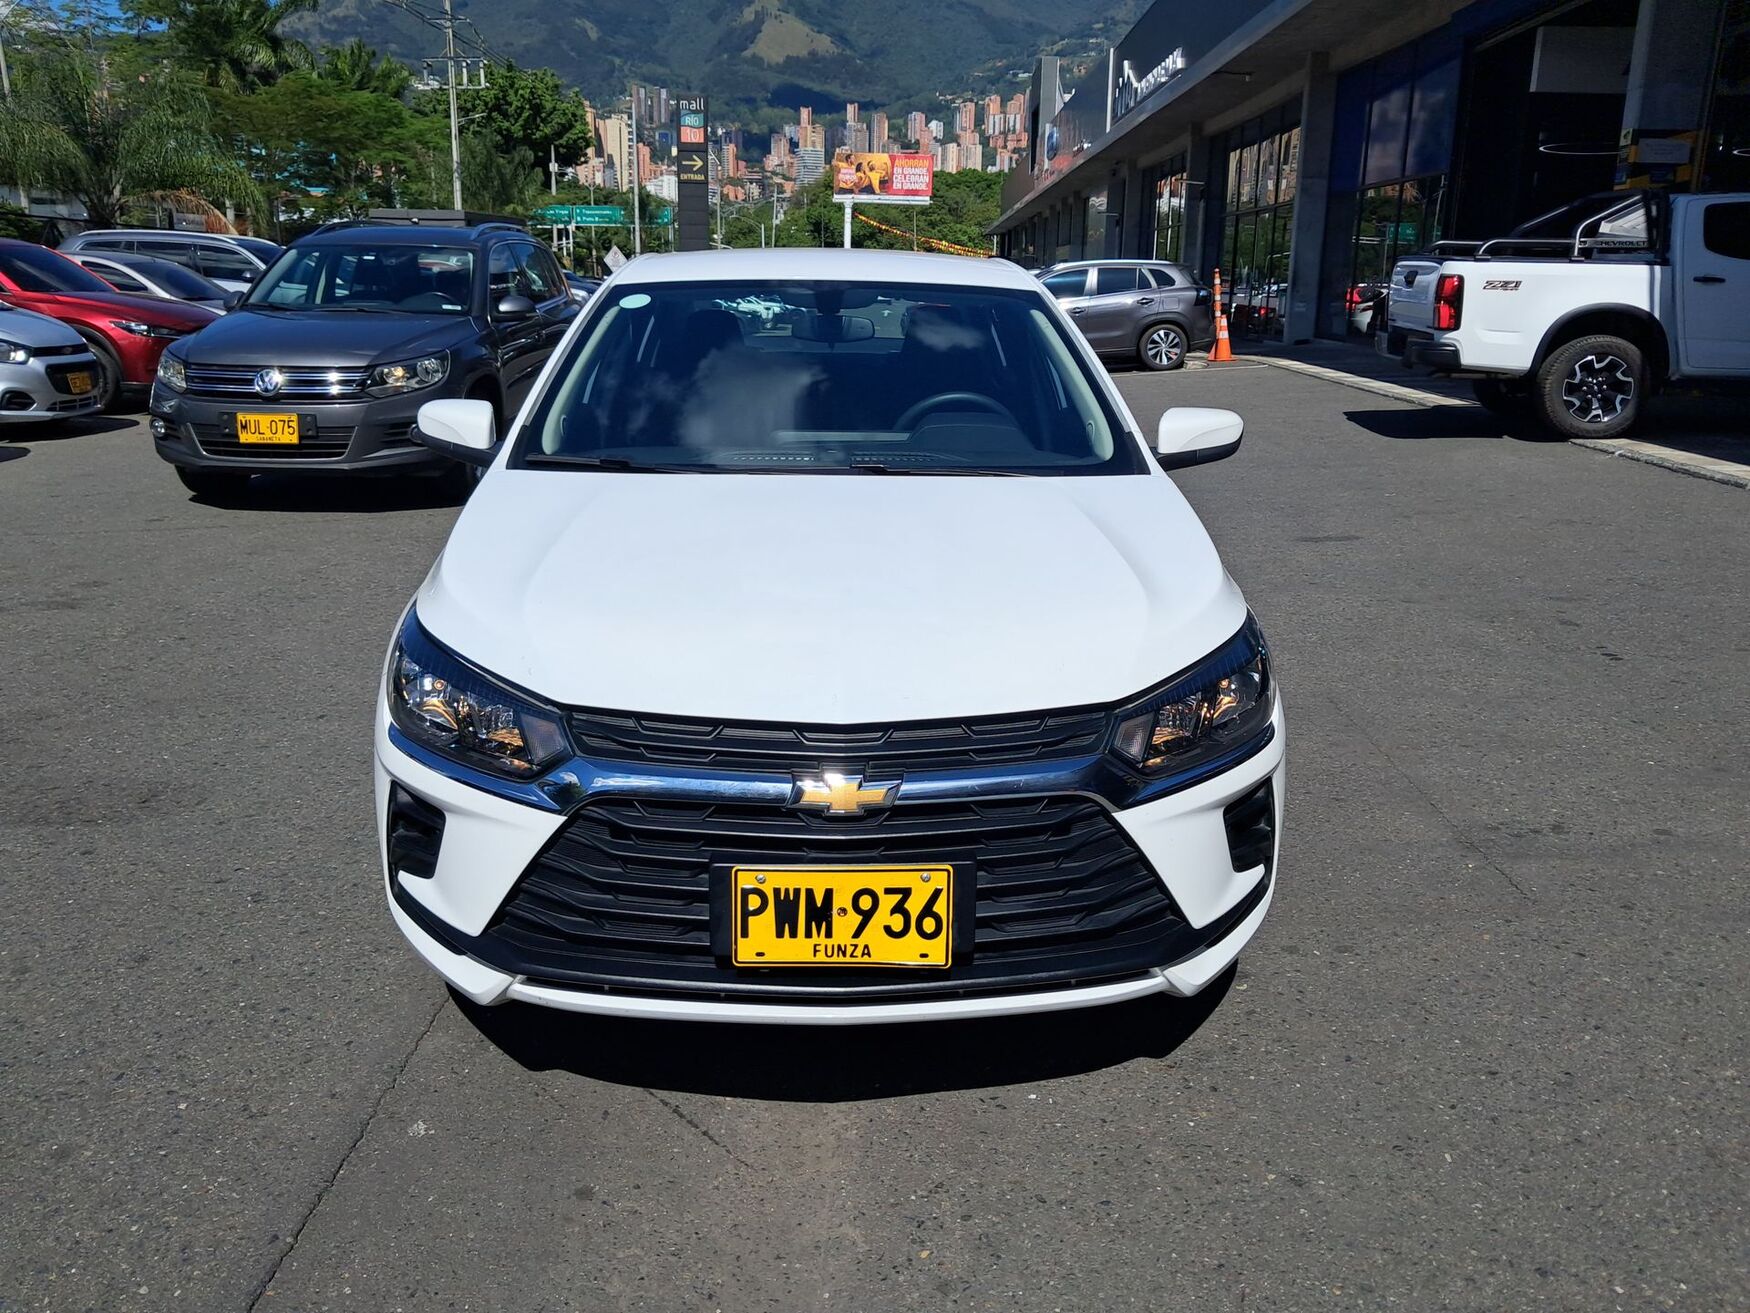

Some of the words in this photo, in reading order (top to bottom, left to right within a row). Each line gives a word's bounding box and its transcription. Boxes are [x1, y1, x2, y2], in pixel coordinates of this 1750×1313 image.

[680, 97, 704, 110] mall
[686, 128, 699, 141] 10
[851, 887, 944, 940] 936
[813, 944, 871, 958] FUNZA
